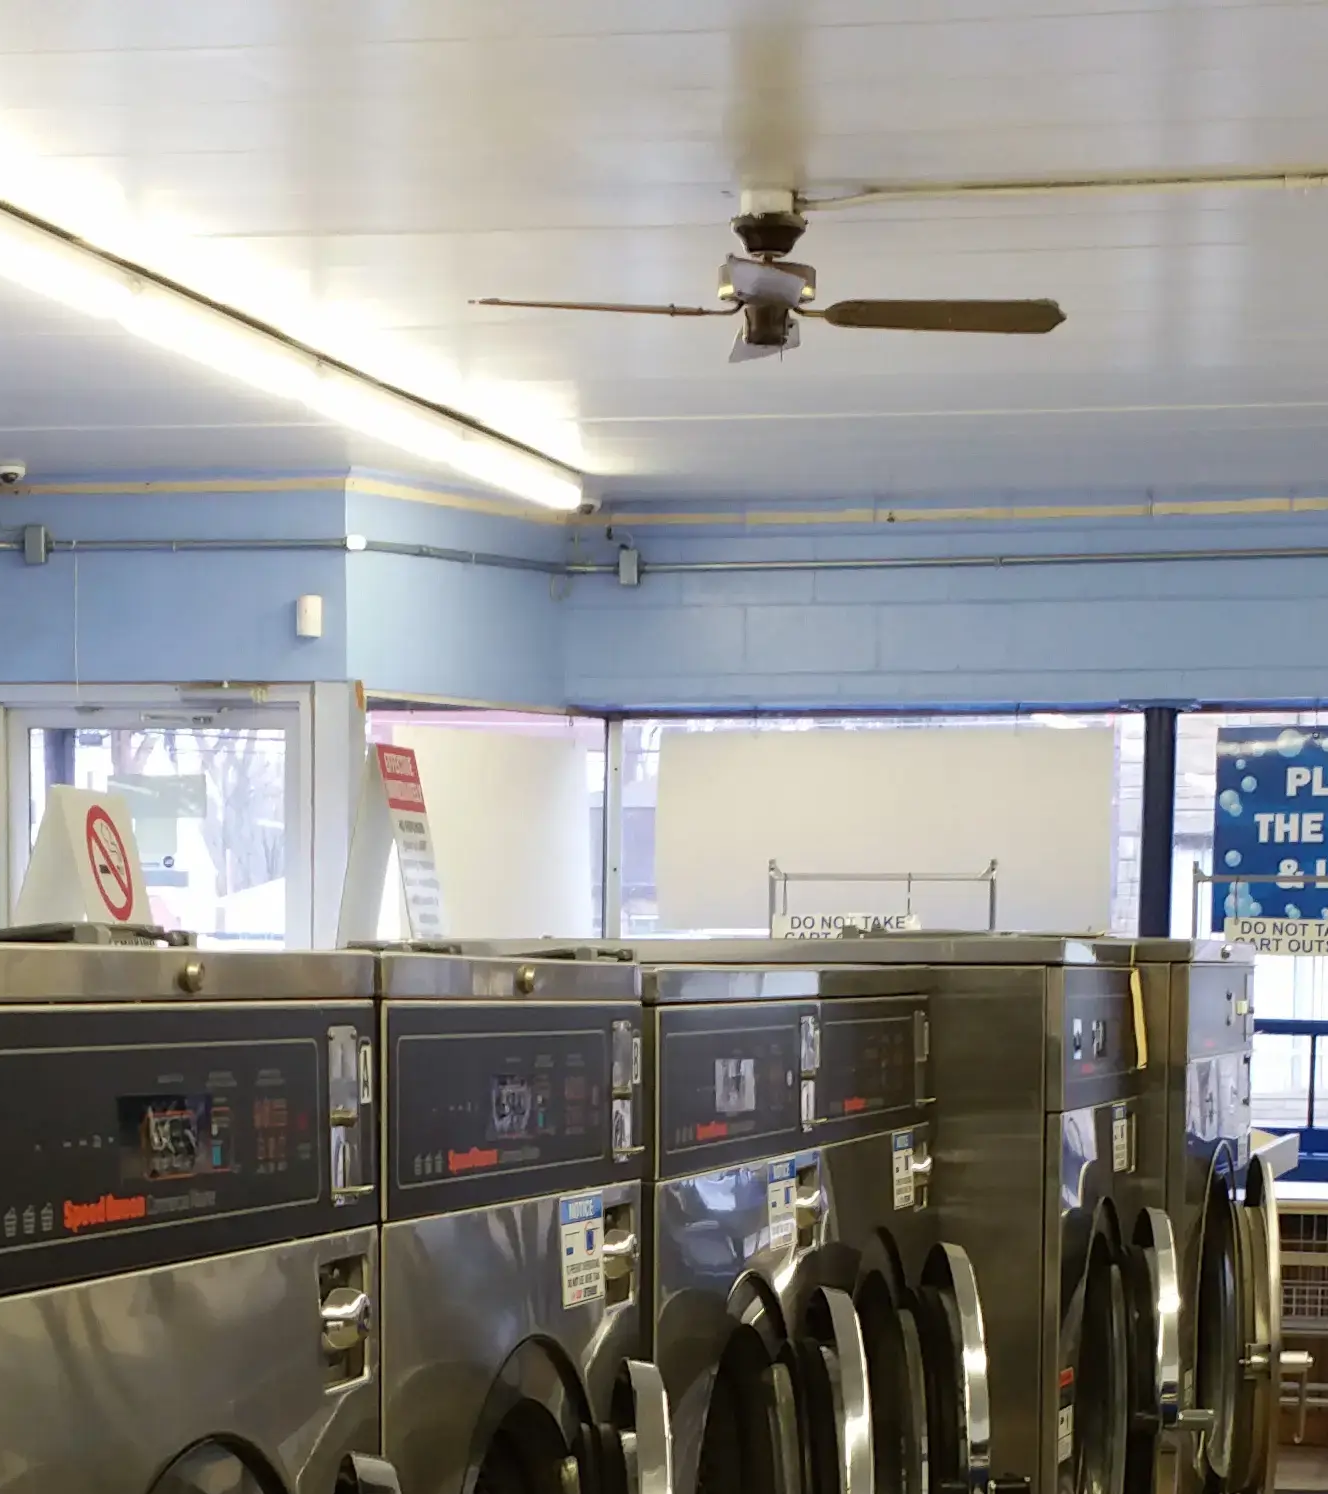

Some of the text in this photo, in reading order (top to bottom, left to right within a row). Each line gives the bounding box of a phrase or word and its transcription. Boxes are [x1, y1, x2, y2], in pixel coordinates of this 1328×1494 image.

[1254, 813, 1324, 843] THE
[1276, 858, 1305, 888] &
[790, 916, 815, 929] DO
[863, 916, 905, 929] TAKE
[1240, 921, 1266, 934] DO
[1272, 922, 1309, 937] NOT
